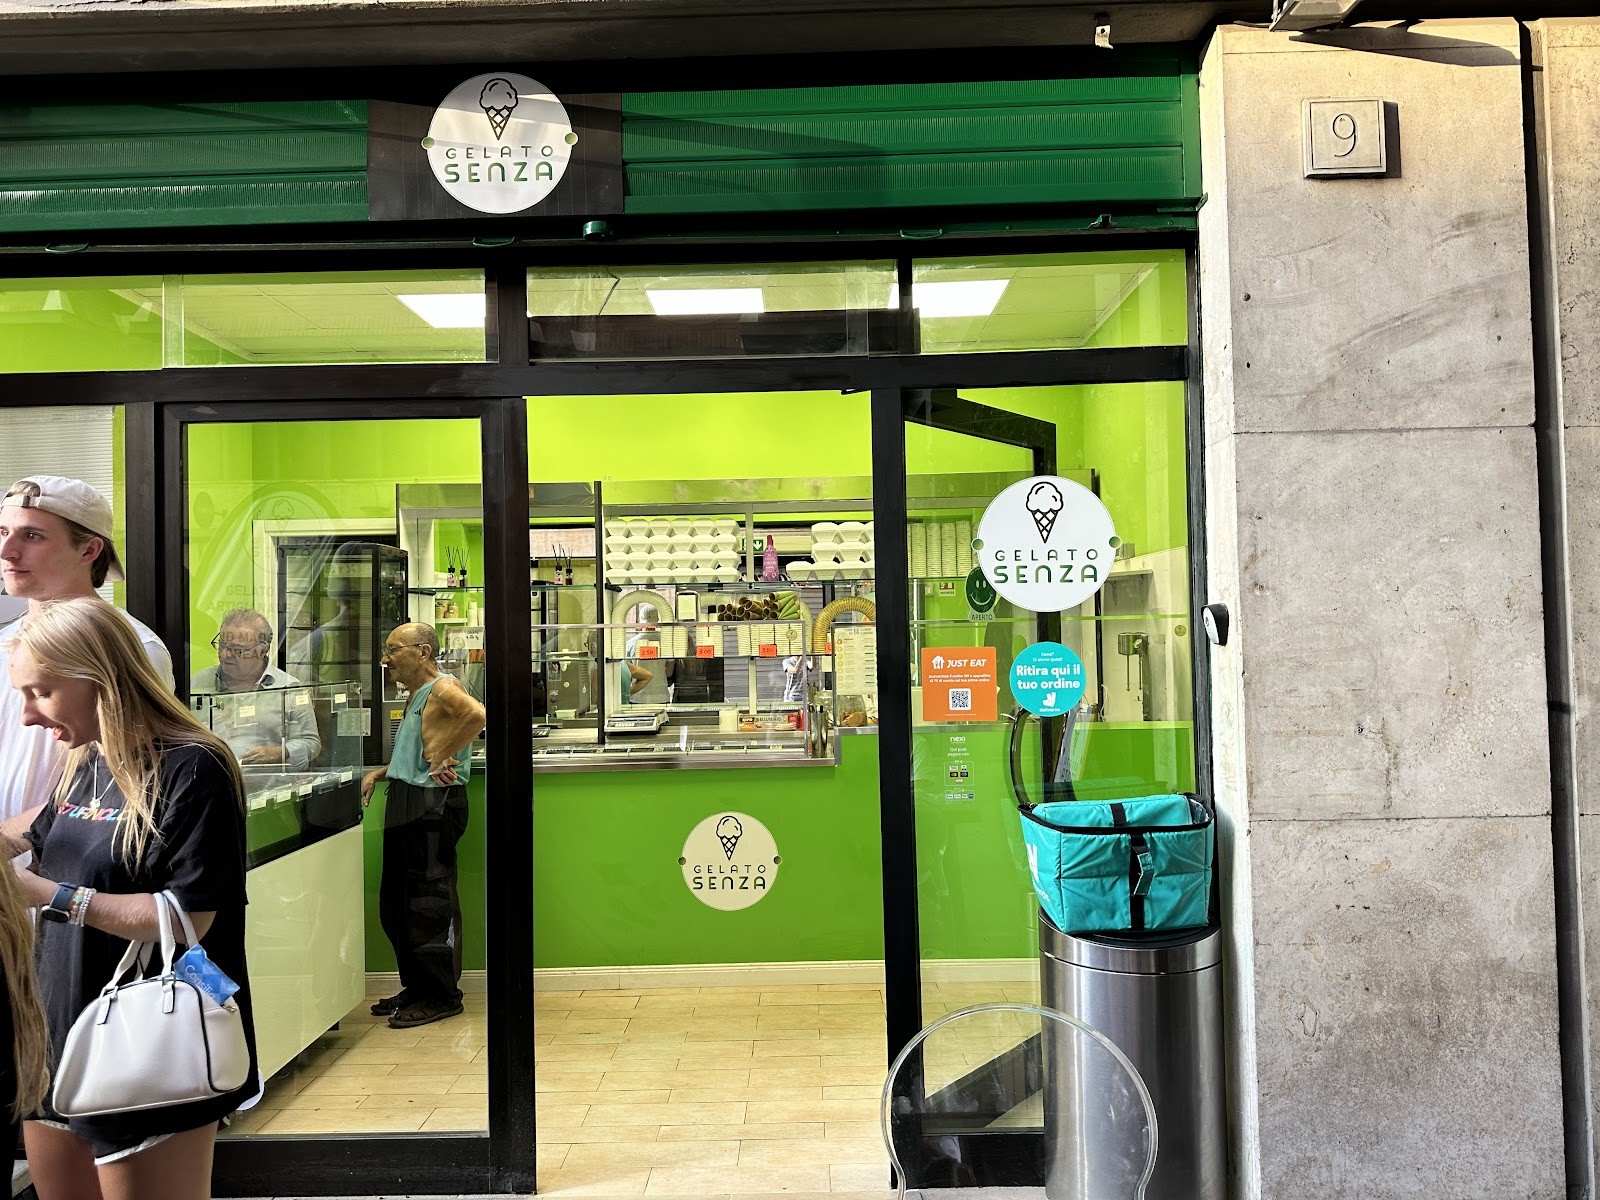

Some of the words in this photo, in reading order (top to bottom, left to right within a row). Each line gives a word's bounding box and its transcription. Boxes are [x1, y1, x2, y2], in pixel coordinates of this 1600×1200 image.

[1332, 113, 1357, 158] 9
[445, 145, 554, 160] GELATO
[443, 161, 553, 183] SENZA
[994, 549, 1098, 561] GELATO
[993, 564, 1098, 583] SENZA
[946, 659, 969, 669] JUST
[969, 658, 988, 668] EAT
[1016, 665, 1048, 676] Ritira
[1051, 664, 1070, 678] qui
[1073, 663, 1081, 675] il
[1017, 680, 1038, 689] tuo
[1040, 678, 1081, 689] ordine
[693, 864, 766, 874] GELATO
[692, 876, 766, 890] SENZA
